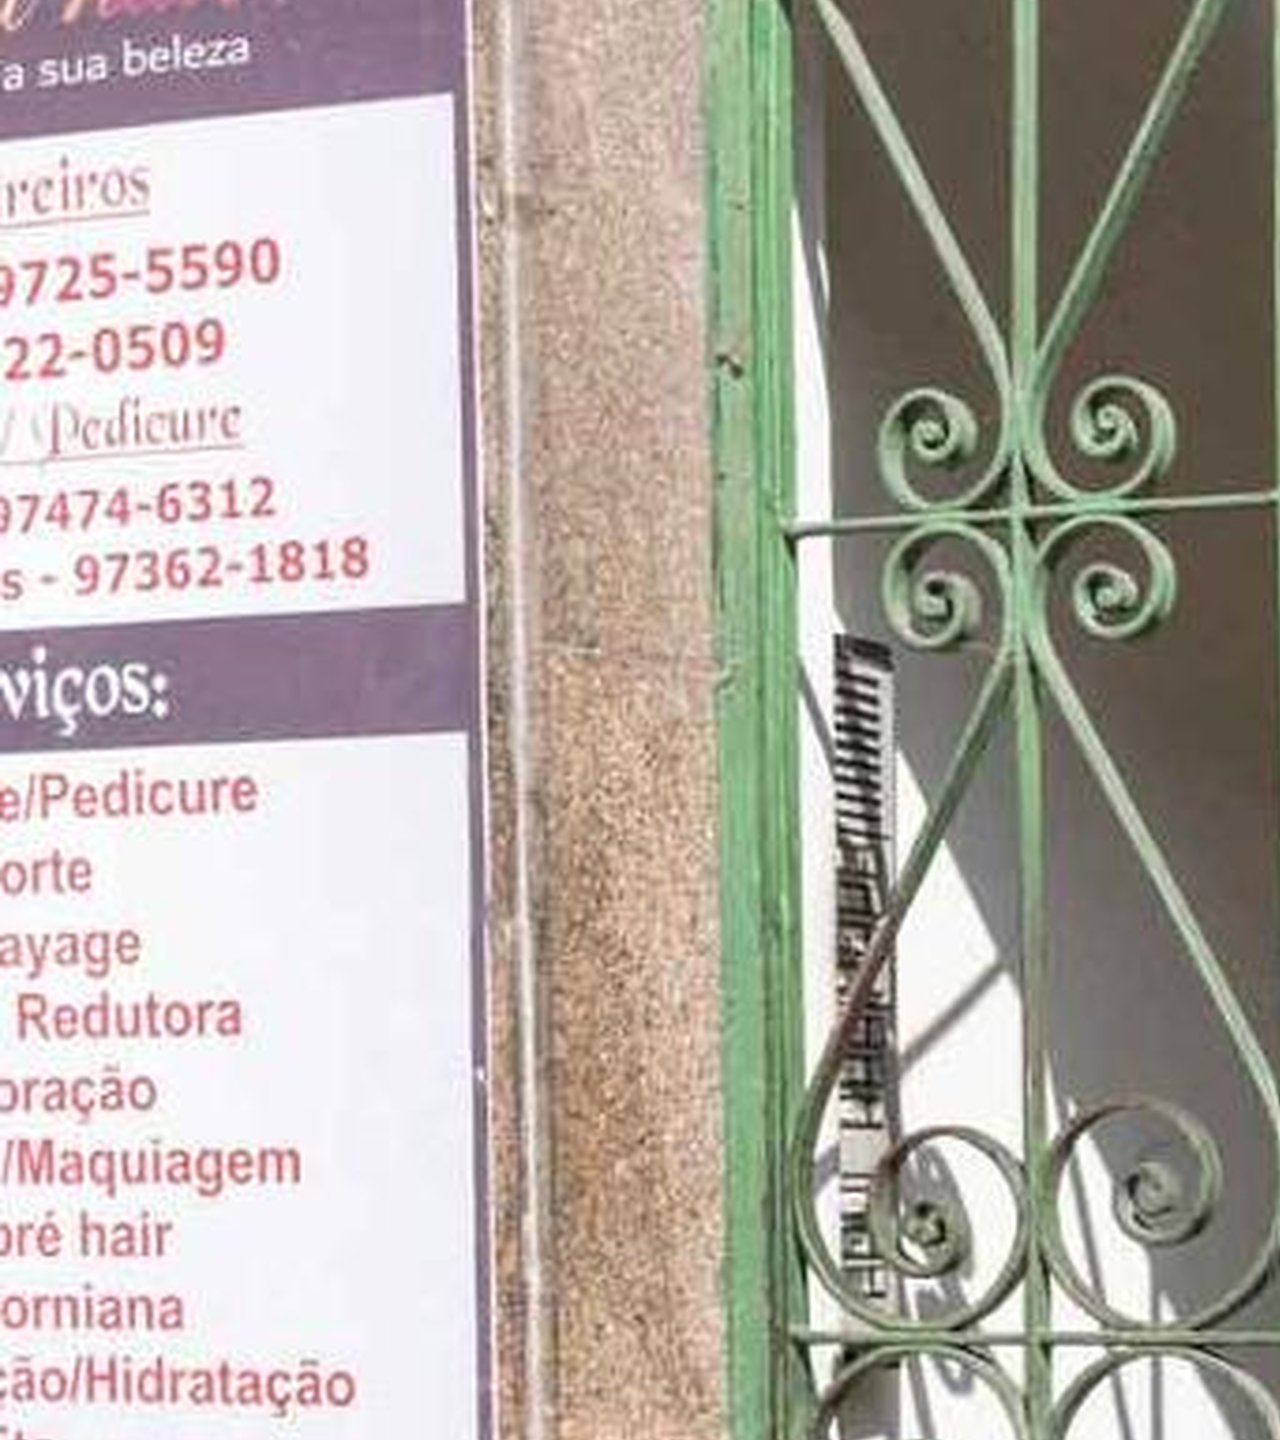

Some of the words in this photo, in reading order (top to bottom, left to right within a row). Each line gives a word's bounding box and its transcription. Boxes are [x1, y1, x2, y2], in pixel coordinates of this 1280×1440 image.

[37, 54, 108, 87] sua
[121, 33, 251, 75] beleza
[3, 318, 227, 382] 22-0509
[74, 535, 371, 597] 97362-1818
[0, 645, 171, 738] viços:
[0, 768, 260, 823] e/Pedicure
[1, 848, 93, 896] orte
[16, 991, 245, 1042] Redutora
[1, 1136, 302, 1198] /Maquiagem
[80, 1210, 175, 1260] hair
[2, 1283, 185, 1332] orniana
